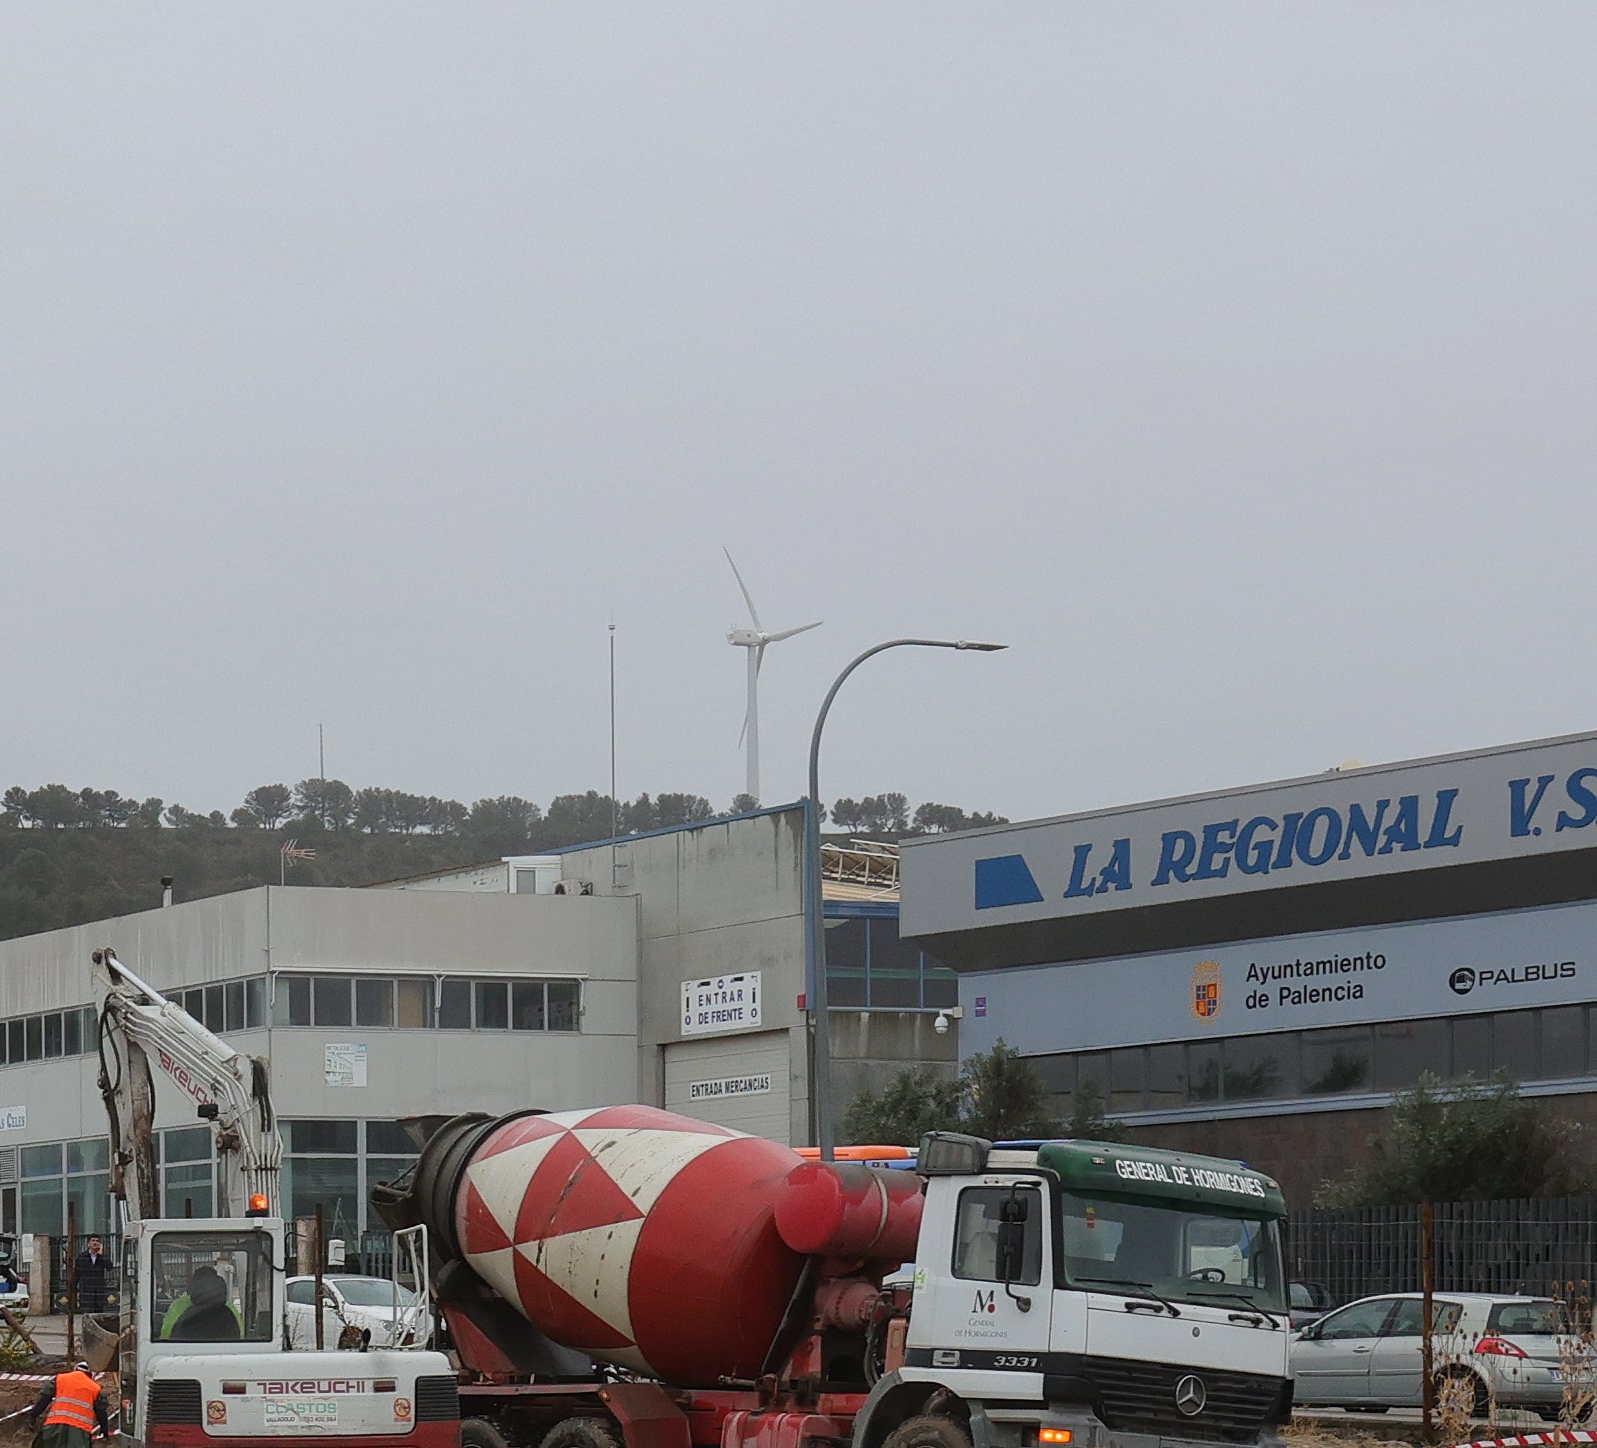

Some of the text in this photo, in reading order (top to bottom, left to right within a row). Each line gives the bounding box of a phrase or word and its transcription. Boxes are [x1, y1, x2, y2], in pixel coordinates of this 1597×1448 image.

[1063, 837, 1134, 898] LA
[1150, 788, 1464, 887] REGIONAL
[1246, 950, 1387, 986] Ayuntamiento
[1479, 961, 1577, 987] PALBUS
[698, 989, 744, 1007] ENTRAR
[1245, 980, 1365, 1009] de Palencia
[698, 1007, 744, 1025] DE FRENTE
[691, 1081, 723, 1098] ENTRADA
[1115, 1159, 1266, 1198] GENERAL DE HORMIGONES
[993, 1356, 1038, 1367] 3331
[265, 1403, 337, 1414] CLASTOS
